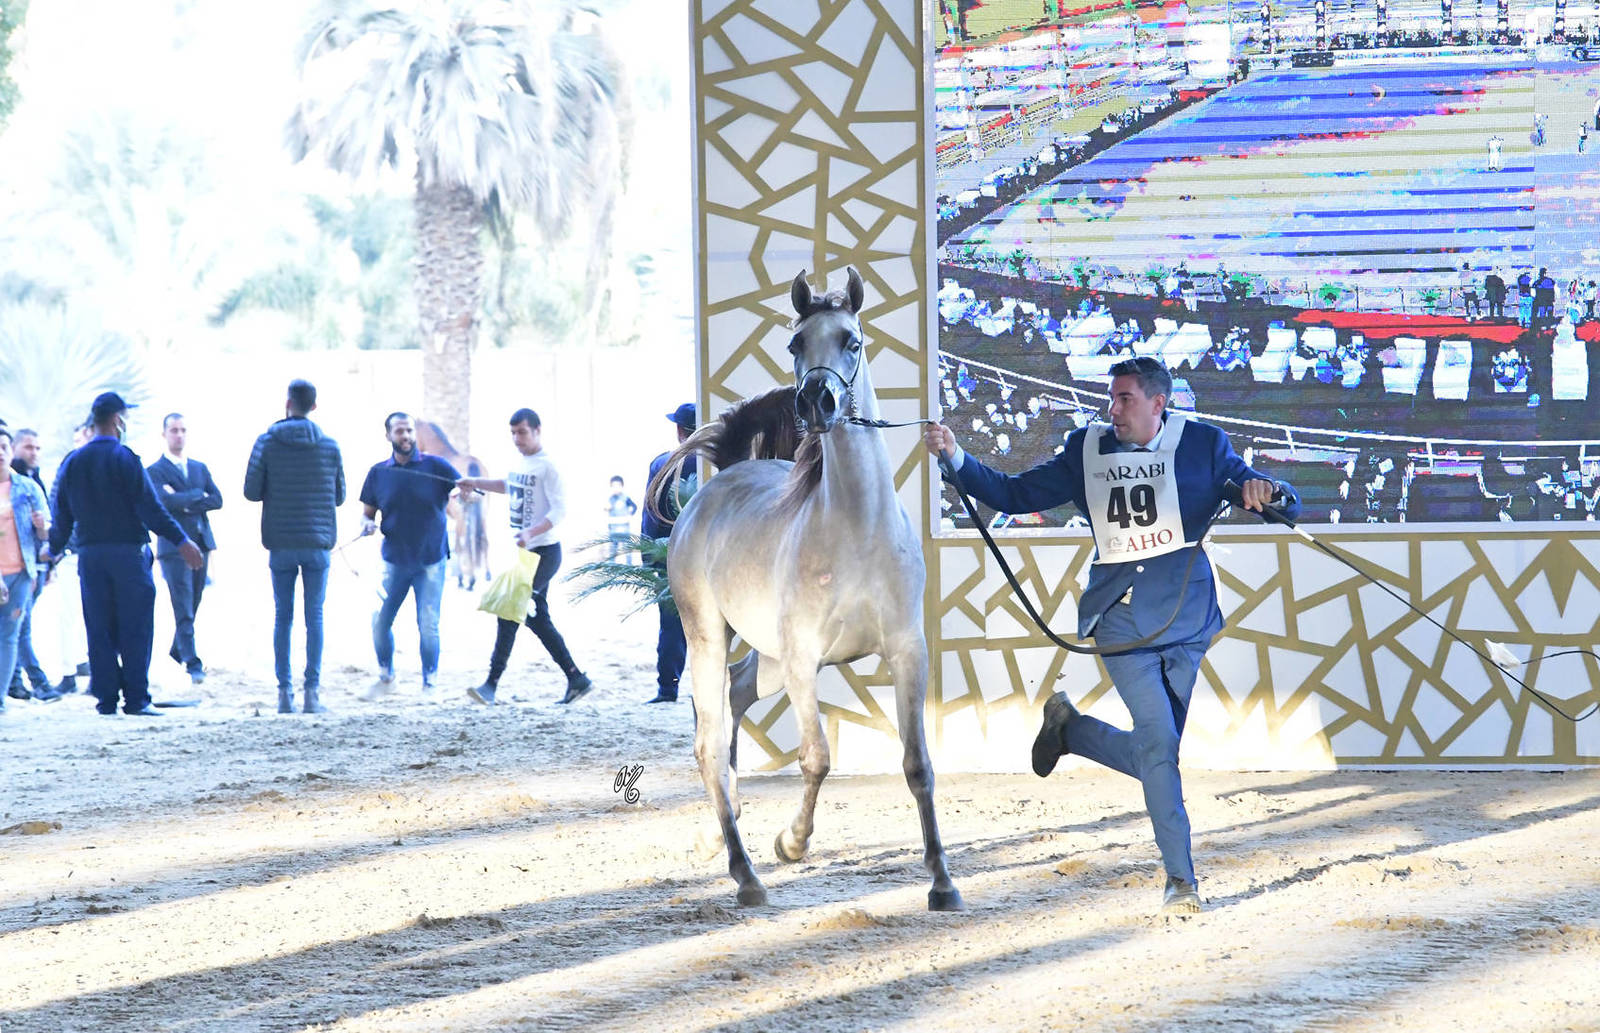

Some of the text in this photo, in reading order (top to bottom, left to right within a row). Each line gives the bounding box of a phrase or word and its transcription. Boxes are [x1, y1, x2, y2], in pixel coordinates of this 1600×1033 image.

[1106, 463, 1164, 481] ARABI
[1107, 484, 1158, 528] 49
[1126, 529, 1173, 552] AHO
